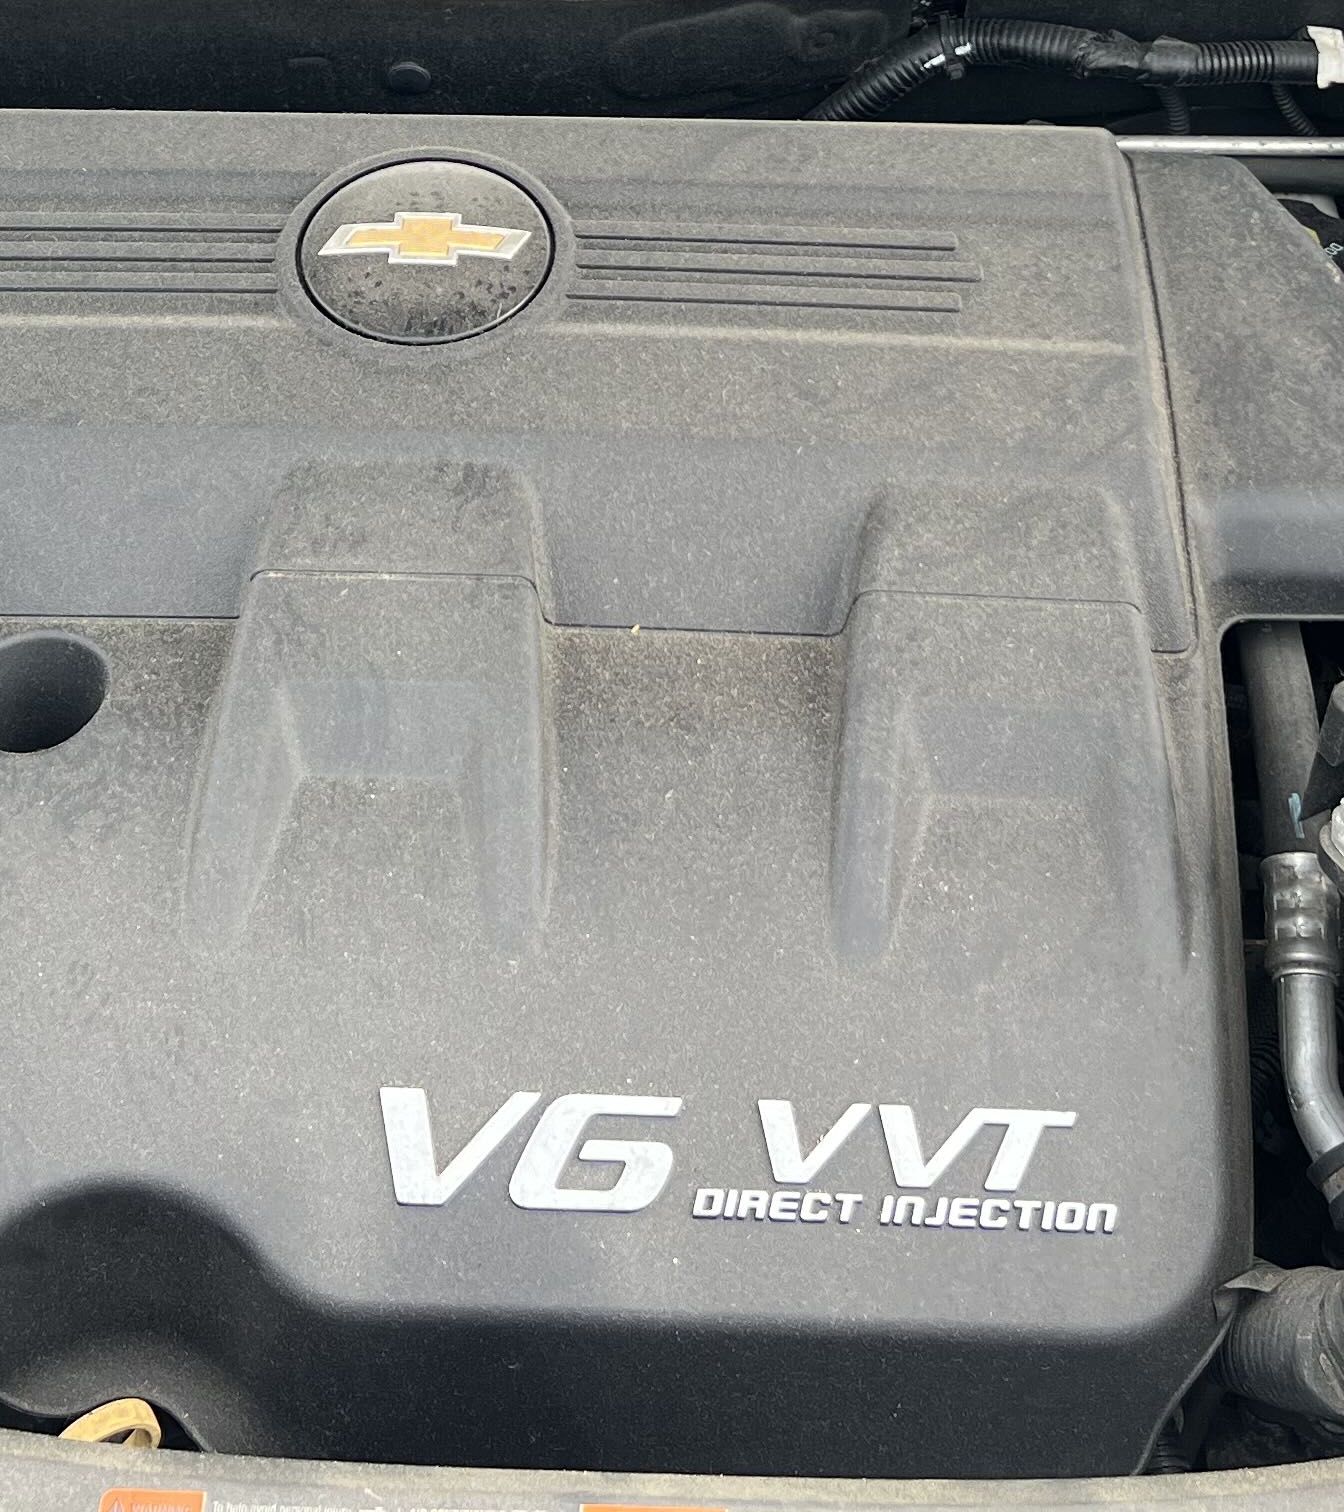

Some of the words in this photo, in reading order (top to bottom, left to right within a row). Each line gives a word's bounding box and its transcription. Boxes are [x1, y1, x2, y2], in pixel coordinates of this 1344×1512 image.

[379, 1086, 683, 1212] V6
[757, 1098, 1077, 1192] VVT
[692, 1187, 863, 1224] DIRECT
[879, 1194, 1118, 1233] INJECTION
